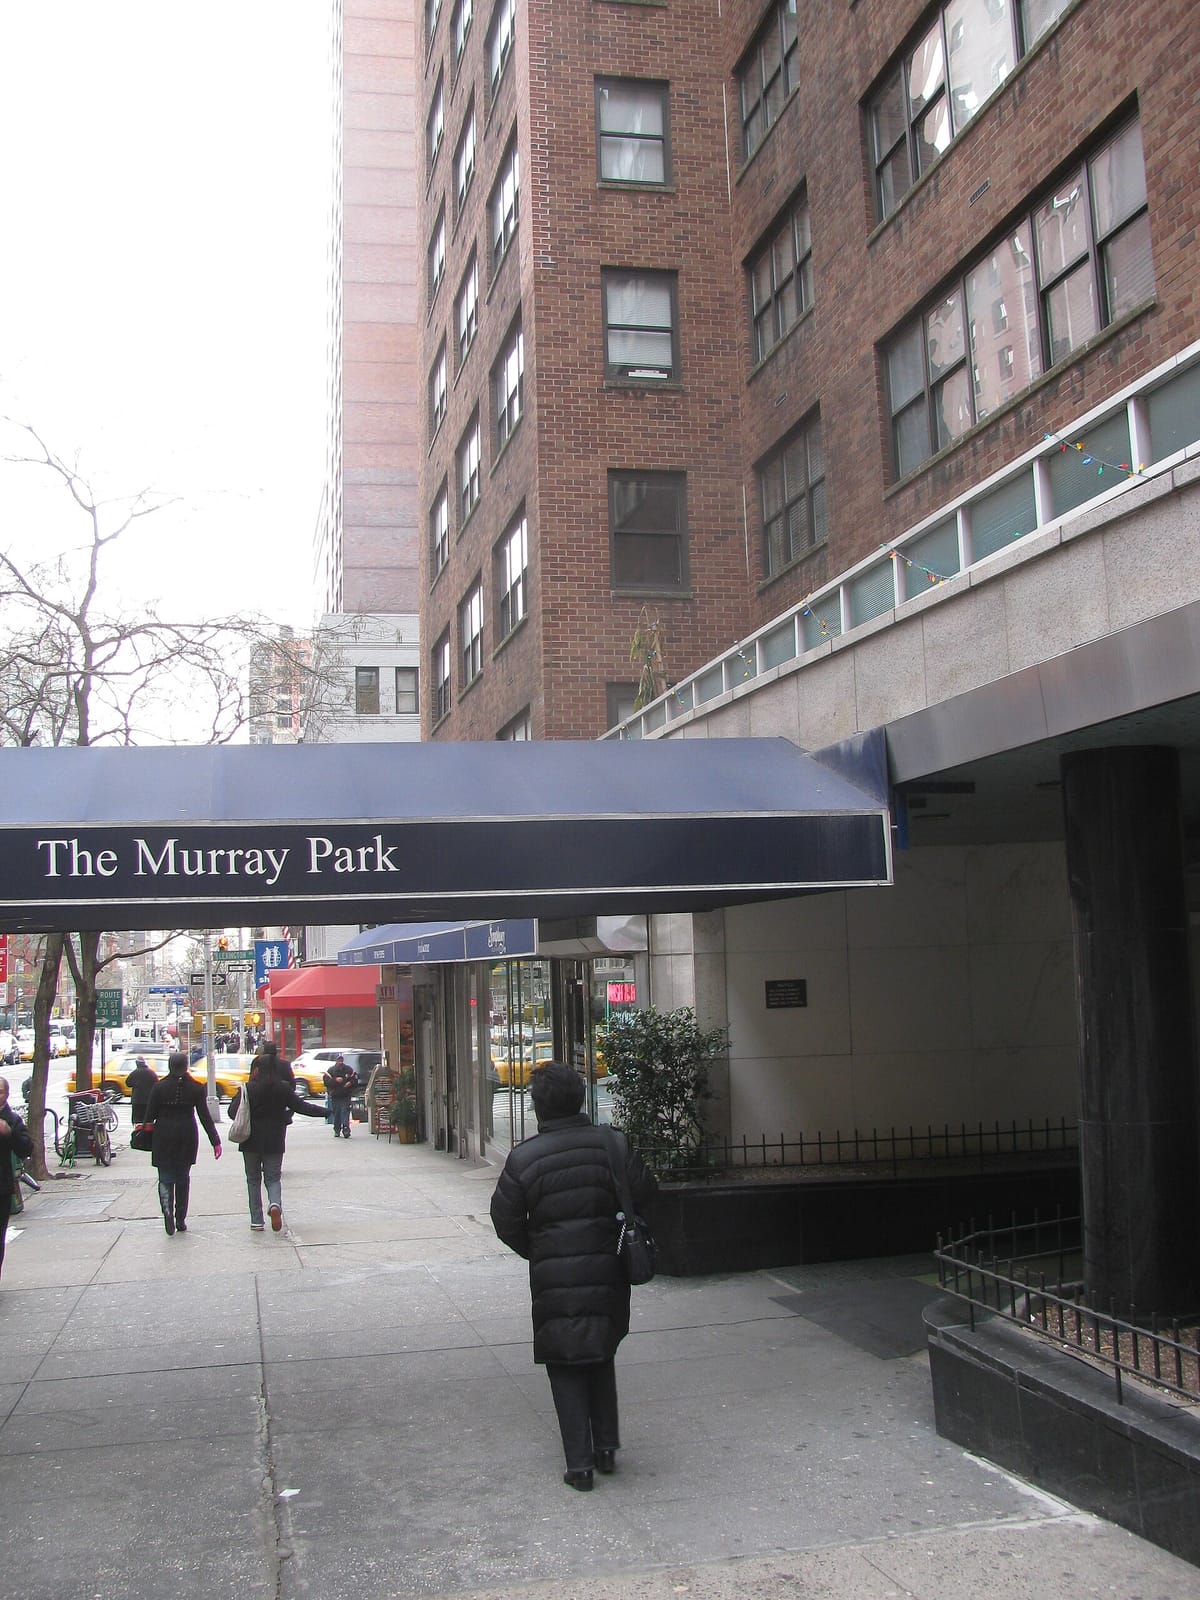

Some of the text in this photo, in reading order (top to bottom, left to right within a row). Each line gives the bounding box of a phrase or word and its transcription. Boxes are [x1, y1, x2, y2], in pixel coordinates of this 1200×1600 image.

[37, 834, 400, 885] The Murray Park
[100, 991, 121, 999] ROUTE
